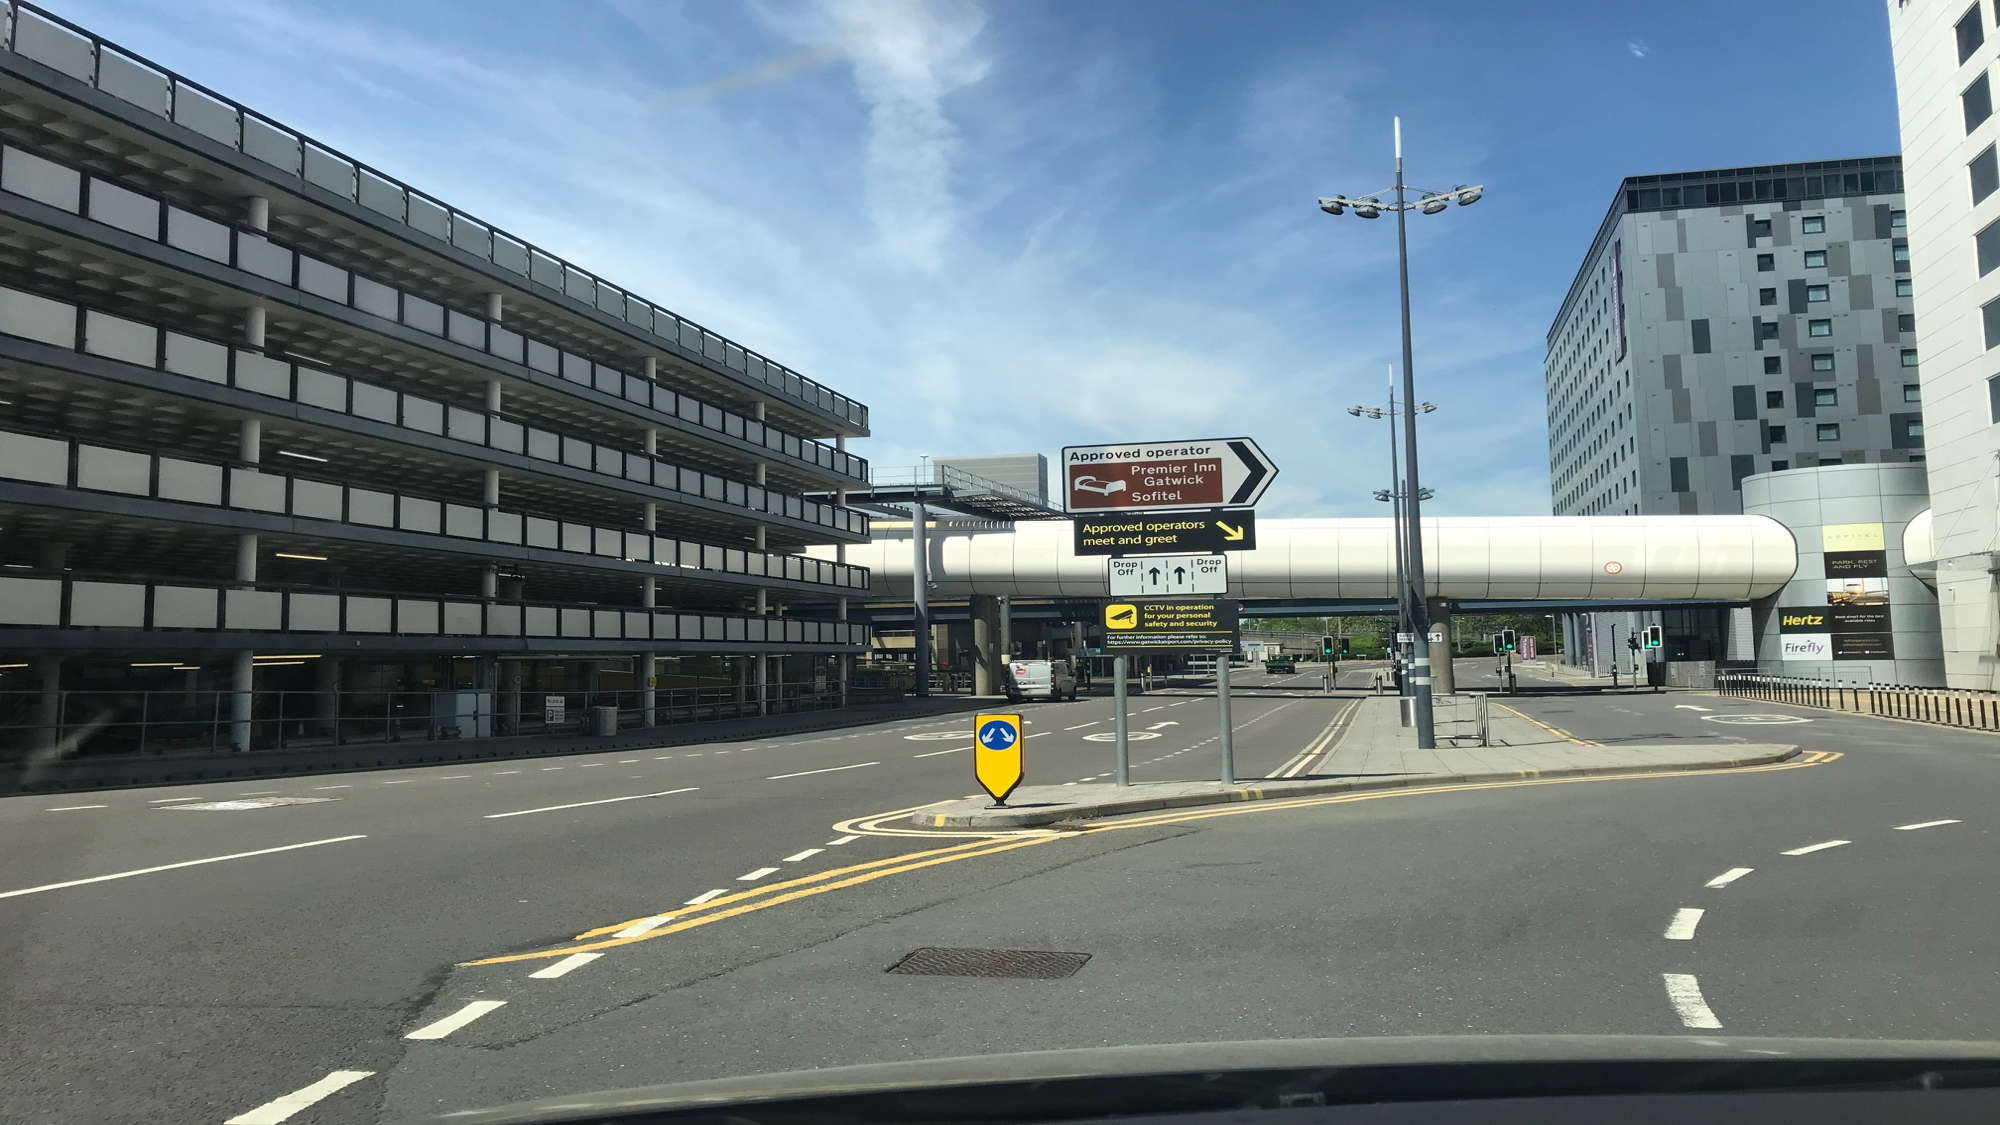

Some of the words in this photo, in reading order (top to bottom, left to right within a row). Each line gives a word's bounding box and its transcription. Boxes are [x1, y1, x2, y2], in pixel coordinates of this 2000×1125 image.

[1069, 448, 1141, 463] Approved
[1146, 445, 1211, 459] operator
[1131, 464, 1188, 476] Premier
[1193, 462, 1217, 473] Inn
[1144, 475, 1204, 487] Gatwick
[1131, 490, 1182, 502] Sofitel
[1082, 521, 1143, 536] Approved
[1146, 520, 1206, 533] operators
[1083, 536, 1115, 546] meet
[1118, 534, 1142, 545] and
[1145, 534, 1178, 546] greet
[1113, 561, 1138, 570] Drop
[1196, 558, 1222, 567] Drop
[1117, 568, 1135, 576] Off
[1200, 566, 1218, 574] Off
[1175, 604, 1215, 612] operation
[1176, 611, 1211, 620] personal
[1783, 614, 1823, 626] Hertz
[1144, 620, 1168, 628] safety
[1186, 620, 1218, 628] security
[1785, 642, 1824, 655] Firefly
